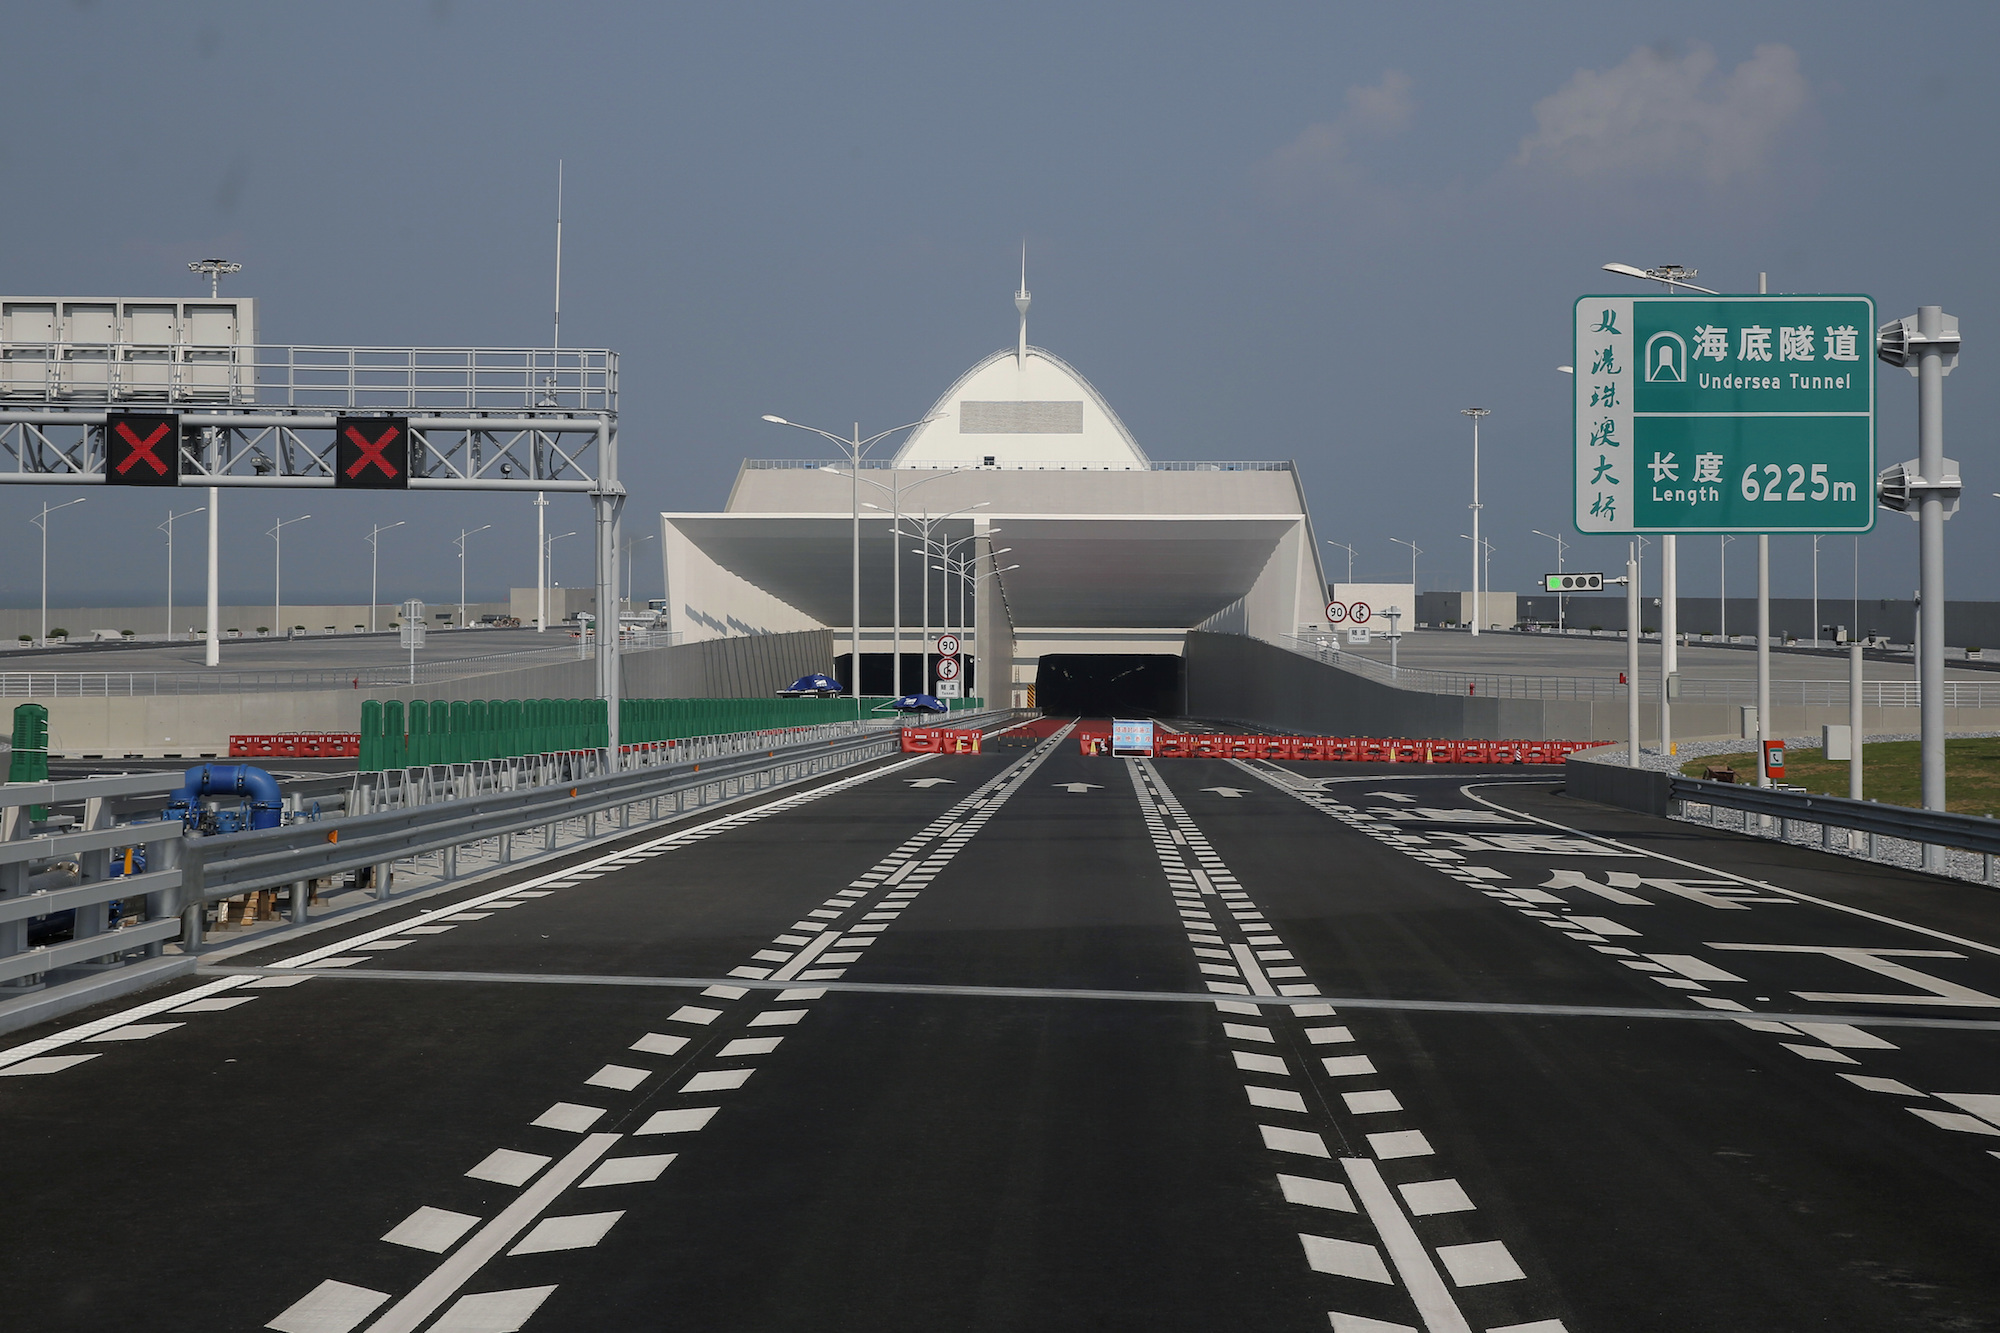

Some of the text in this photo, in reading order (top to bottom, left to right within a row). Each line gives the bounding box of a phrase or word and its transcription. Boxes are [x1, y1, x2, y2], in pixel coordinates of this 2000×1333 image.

[1691, 325, 1860, 362] 海底隧道
[1699, 373, 1851, 390] Undersea Tunnel
[1647, 452, 1724, 484] 长度
[1741, 463, 1857, 502] 6225m
[1652, 486, 1720, 506] Length
[1330, 607, 1343, 617] 90
[942, 641, 955, 650] 90
